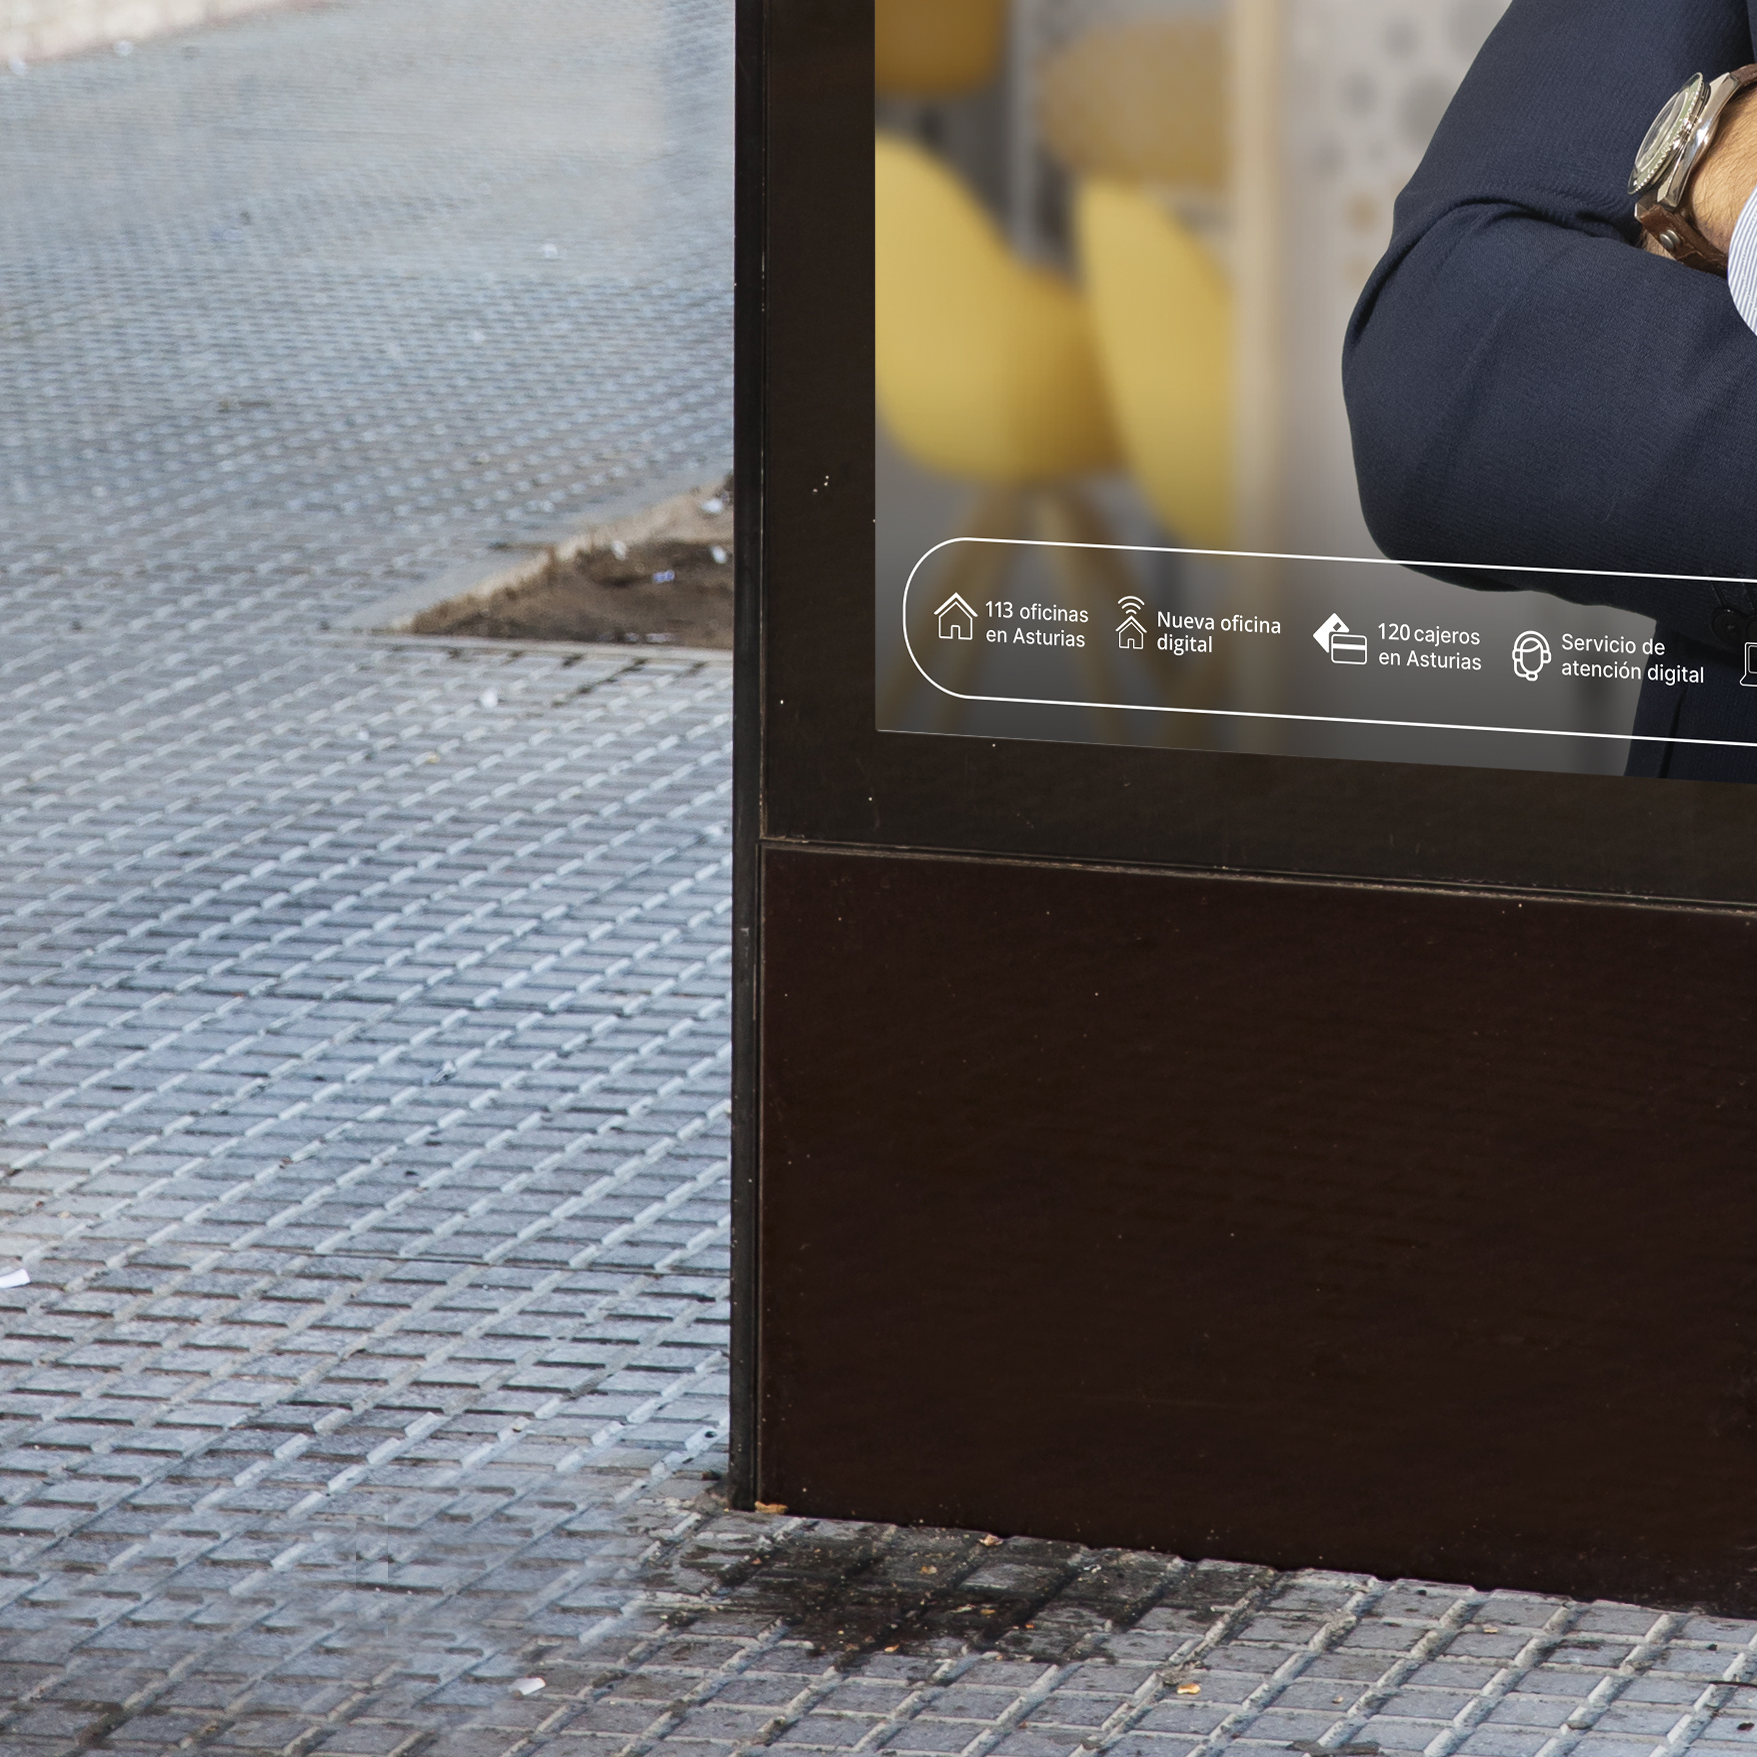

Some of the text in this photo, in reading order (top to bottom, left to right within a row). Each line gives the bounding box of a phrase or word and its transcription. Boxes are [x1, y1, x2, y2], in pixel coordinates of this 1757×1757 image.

[985, 600, 1089, 623] 113 oficinas
[1157, 611, 1281, 634] Nueva oficina
[986, 627, 1086, 648] en Asturias
[1157, 633, 1212, 656] digital
[1378, 622, 1481, 647] 120 cajeros
[1561, 633, 1666, 656] Servicio de
[1378, 649, 1482, 671] en Asturias
[1561, 660, 1704, 686] atención digital
